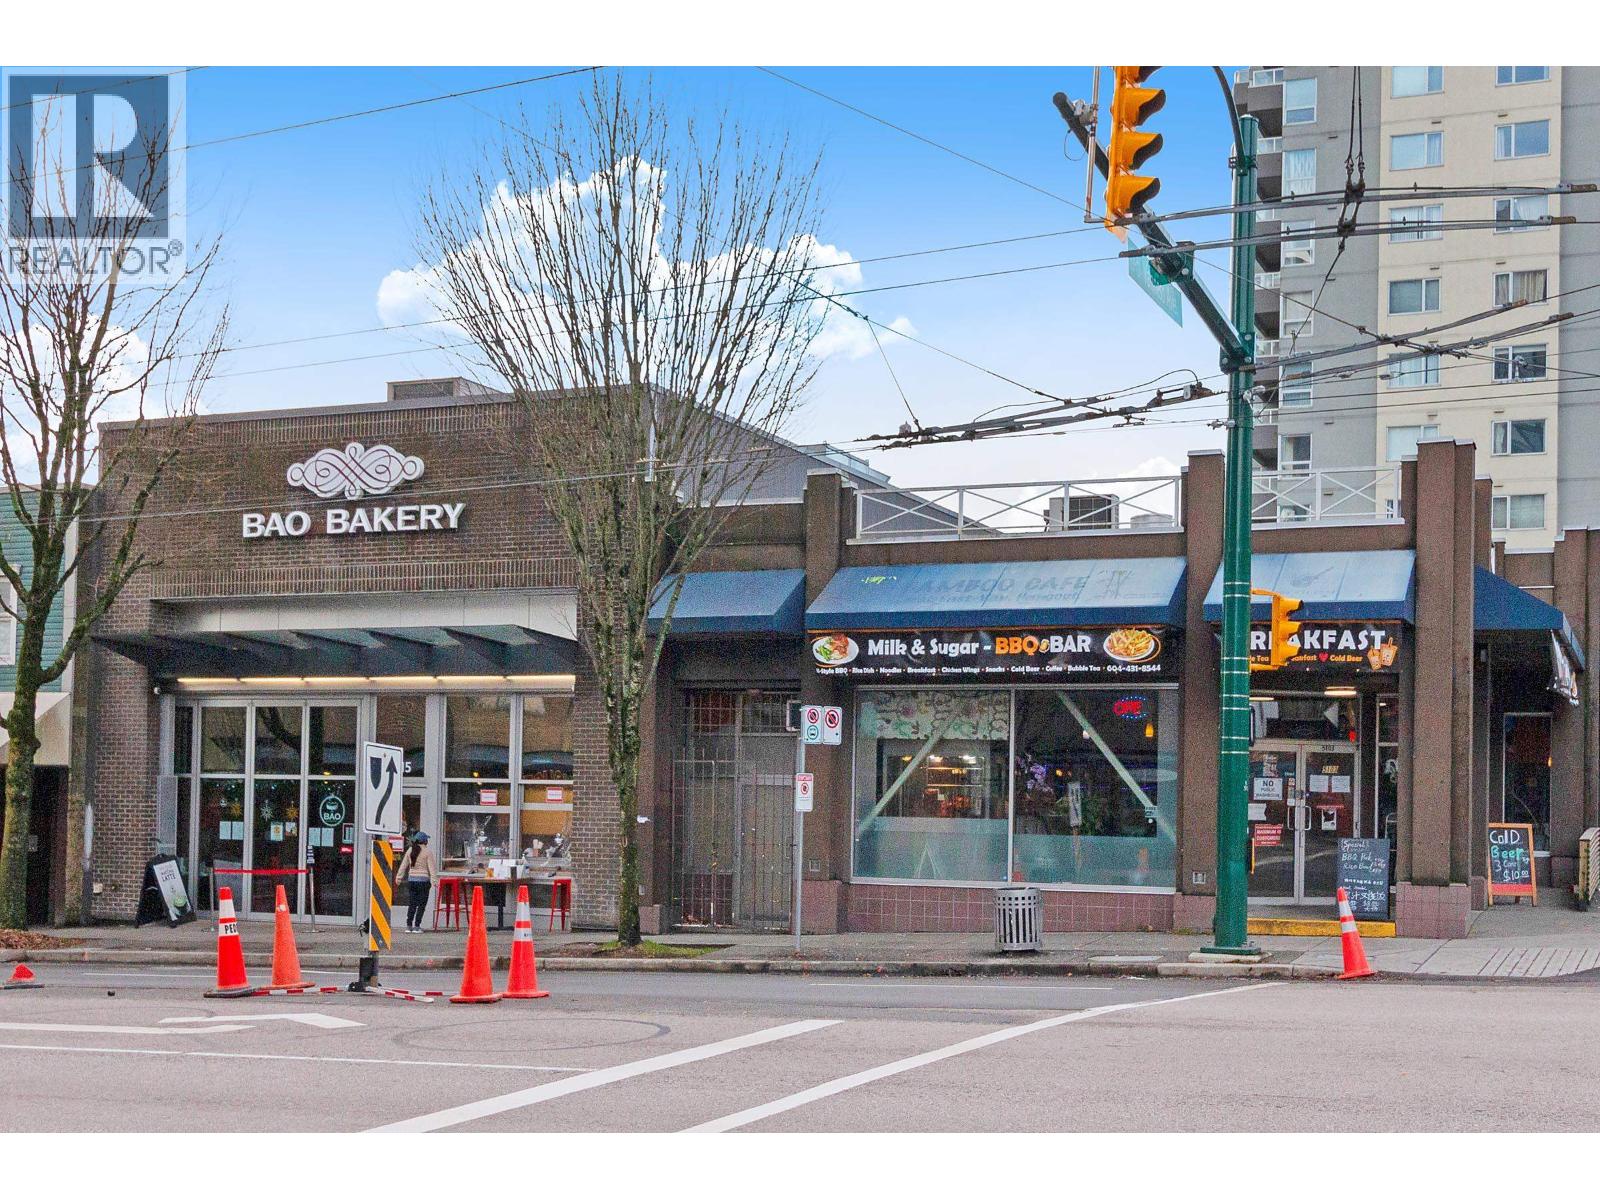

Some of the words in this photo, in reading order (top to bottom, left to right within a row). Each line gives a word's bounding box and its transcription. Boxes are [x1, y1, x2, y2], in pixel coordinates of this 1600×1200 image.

[242, 510, 311, 538] BAO
[326, 502, 466, 534] BAKERY
[867, 638, 908, 656] Milk
[910, 638, 926, 656] &
[929, 637, 980, 657] Sugar
[995, 635, 1040, 657] BBQ
[1049, 634, 1091, 654] BAR
[1250, 629, 1386, 651] RAKFAST
[1257, 654, 1269, 662] Tea
[1330, 654, 1346, 662] Cold
[1346, 654, 1363, 662] Beer
[835, 666, 848, 675] BBQ
[879, 666, 902, 674] Noodles
[907, 666, 937, 674] Breakfast
[941, 666, 962, 674] Chicken
[962, 666, 980, 675] Wings
[985, 665, 1005, 674] Snacks
[1011, 665, 1025, 673] Cold
[1025, 665, 1040, 673] Beer
[1045, 664, 1063, 673] Coffee
[1067, 664, 1089, 673] Bubble
[1089, 664, 1101, 672] Tea
[1106, 663, 1161, 673] 604-431-8544
[1262, 780, 1274, 788] NO
[323, 812, 341, 821] BAO
[1493, 860, 1502, 872] 3
